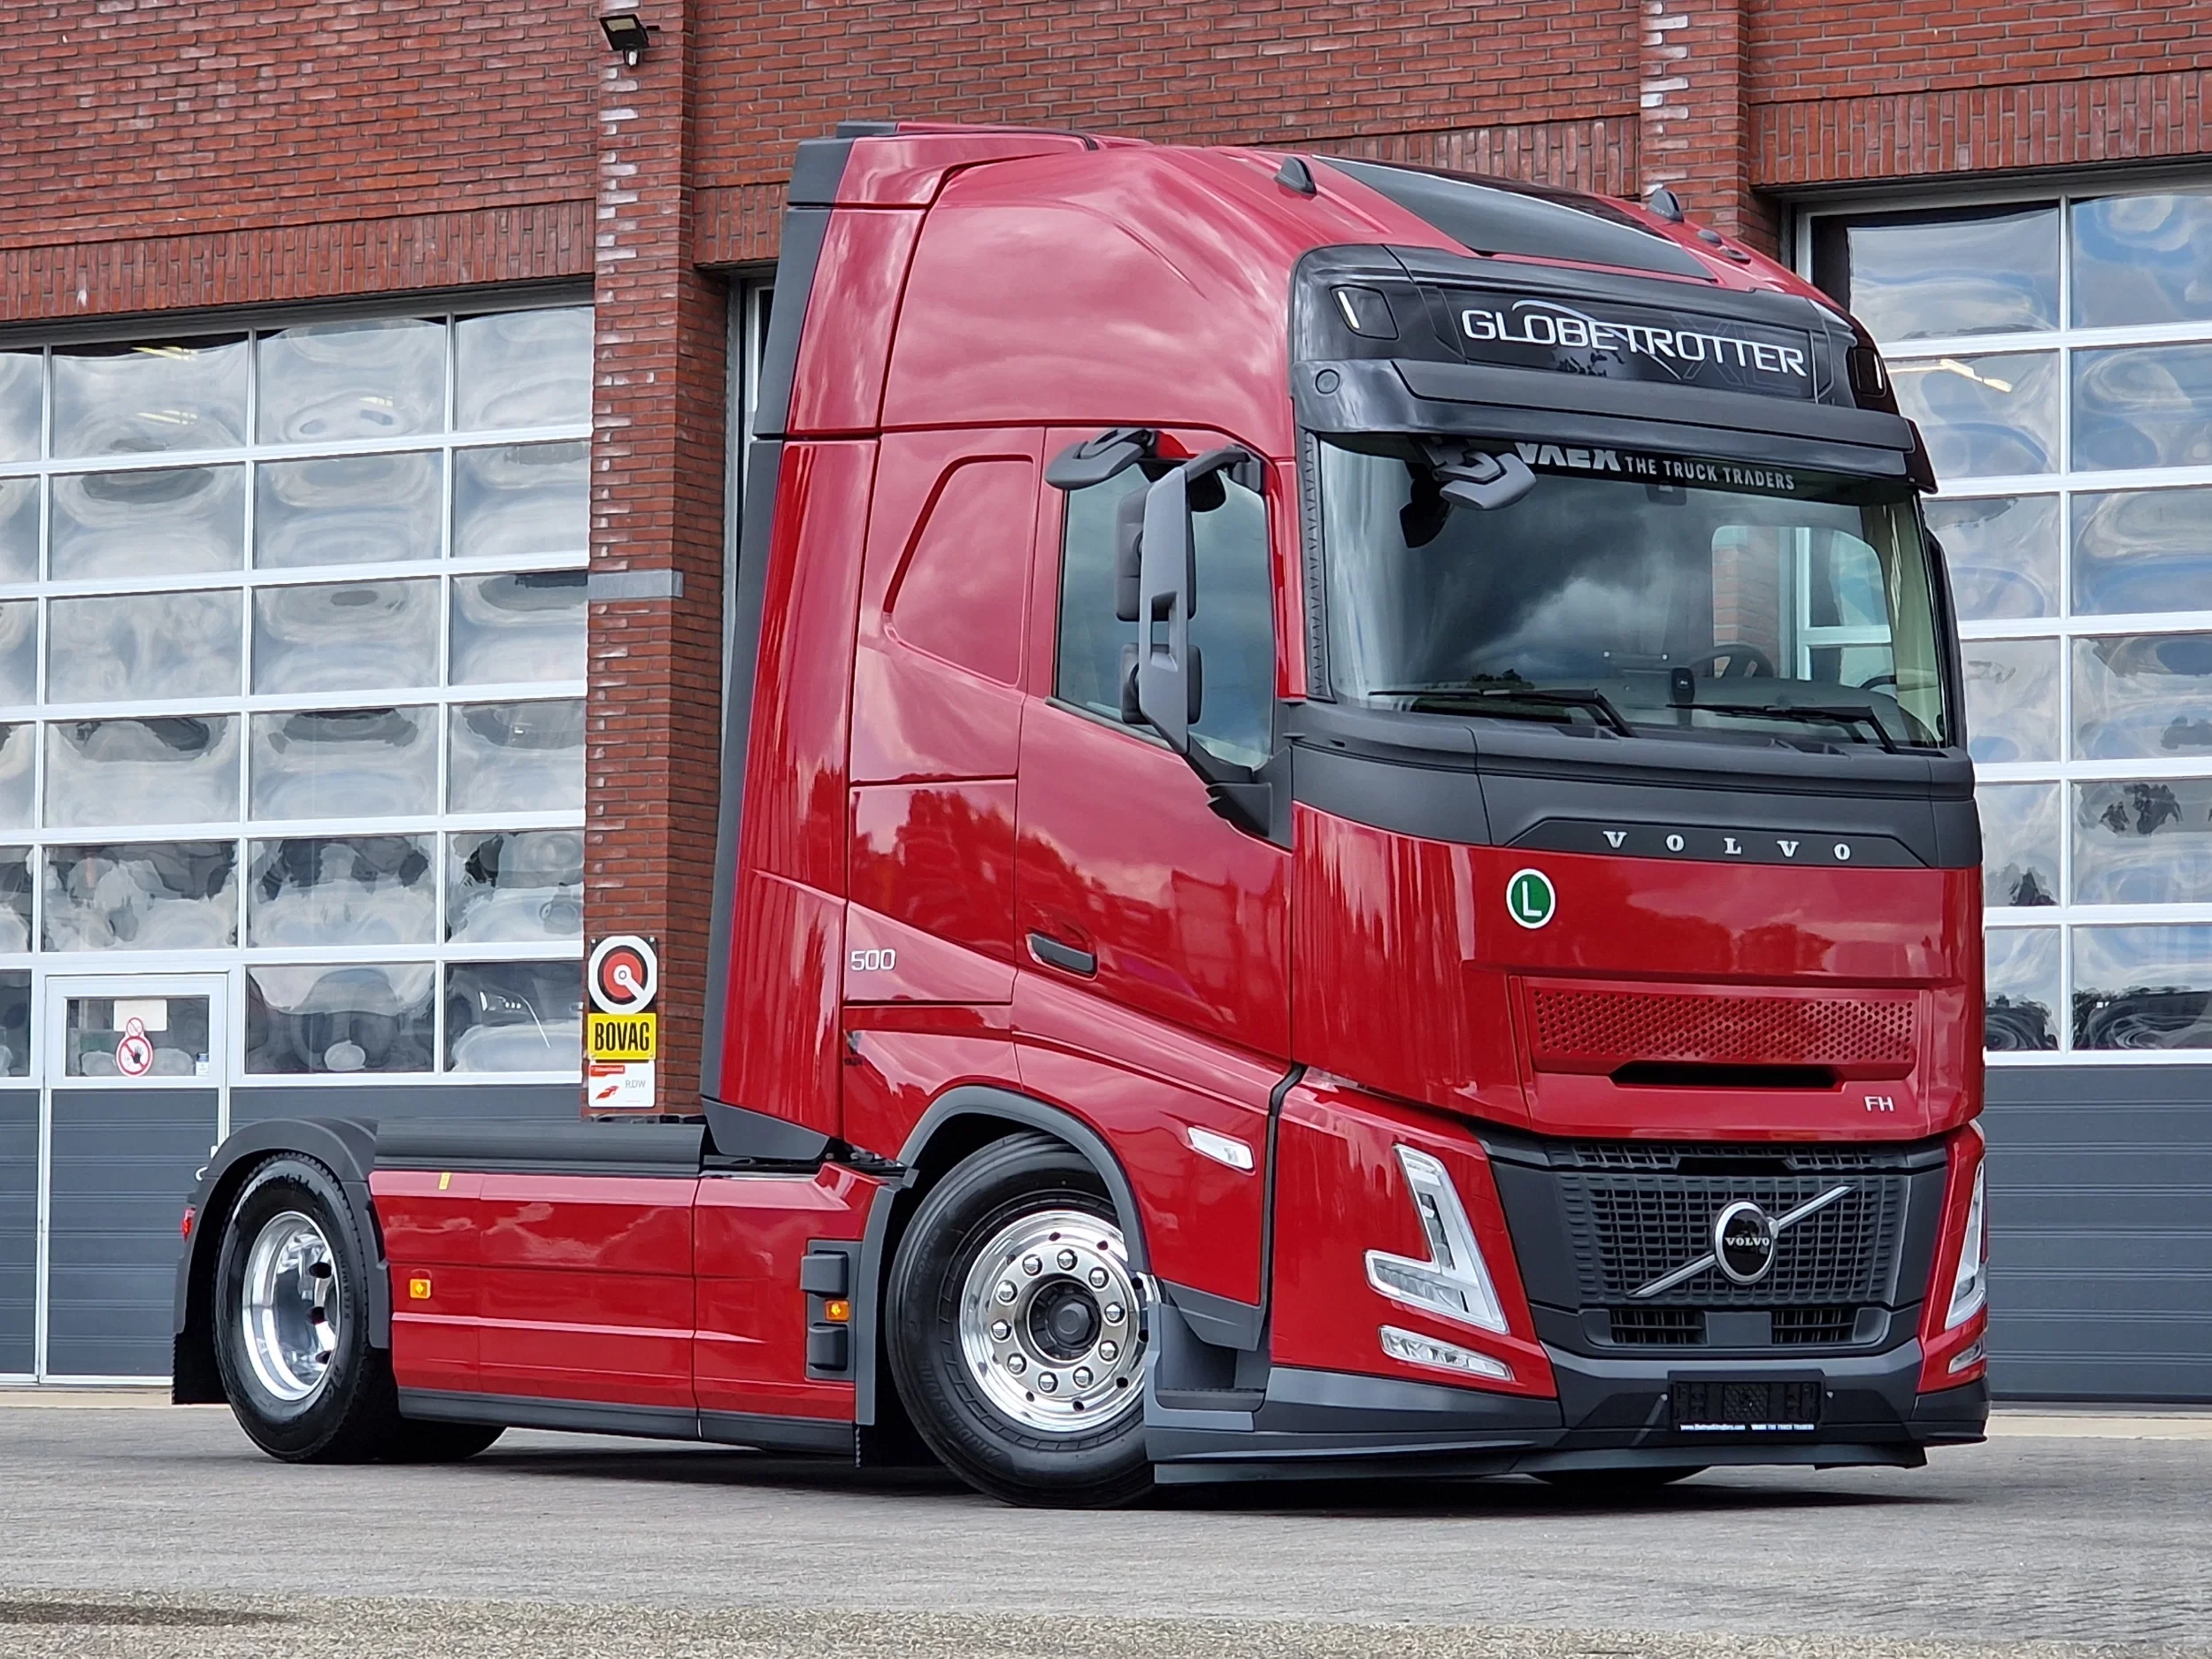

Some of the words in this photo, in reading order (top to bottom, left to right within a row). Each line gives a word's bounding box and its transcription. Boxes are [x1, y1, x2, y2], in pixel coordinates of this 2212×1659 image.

[1461, 308, 1808, 377] GLOBETROTTER
[1514, 442, 1621, 472] VAEX
[1624, 456, 1657, 475] THE
[1663, 460, 1718, 482] TRUCK
[1722, 466, 1795, 490] TRADERS
[1602, 830, 1852, 861] VOLVO
[1521, 880, 1543, 918] L
[850, 949, 896, 971] 500
[595, 1021, 650, 1051] BOVAG
[1864, 1095, 1894, 1112] FH
[1724, 1237, 1770, 1247] VOLVO
